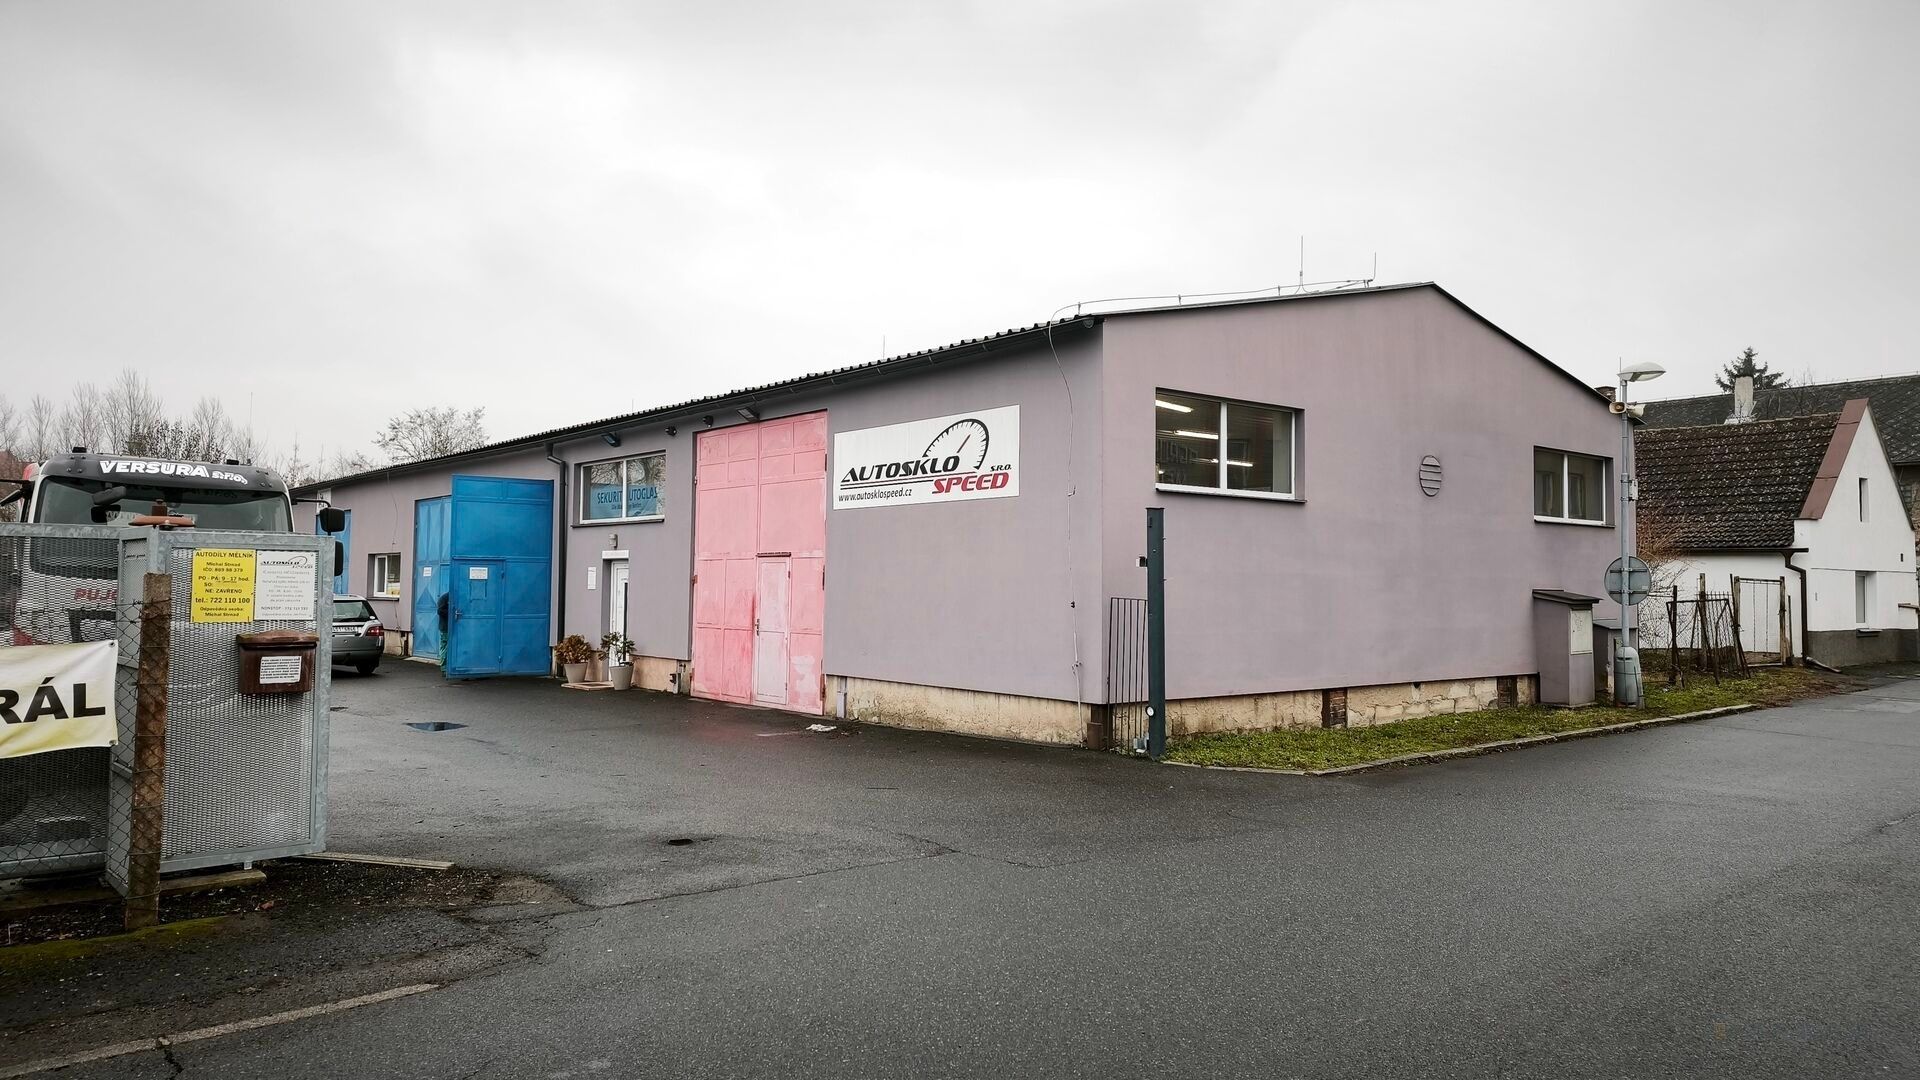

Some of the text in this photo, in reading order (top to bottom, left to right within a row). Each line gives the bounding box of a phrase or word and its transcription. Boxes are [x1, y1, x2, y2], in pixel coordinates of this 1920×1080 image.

[100, 460, 210, 478] VERSURA
[840, 455, 960, 483] AUTOSKLO
[932, 472, 1010, 495] SPEED
[597, 487, 658, 504] SEKURIT UTOGLAS
[838, 487, 912, 502] www.autosklospeed.cz
